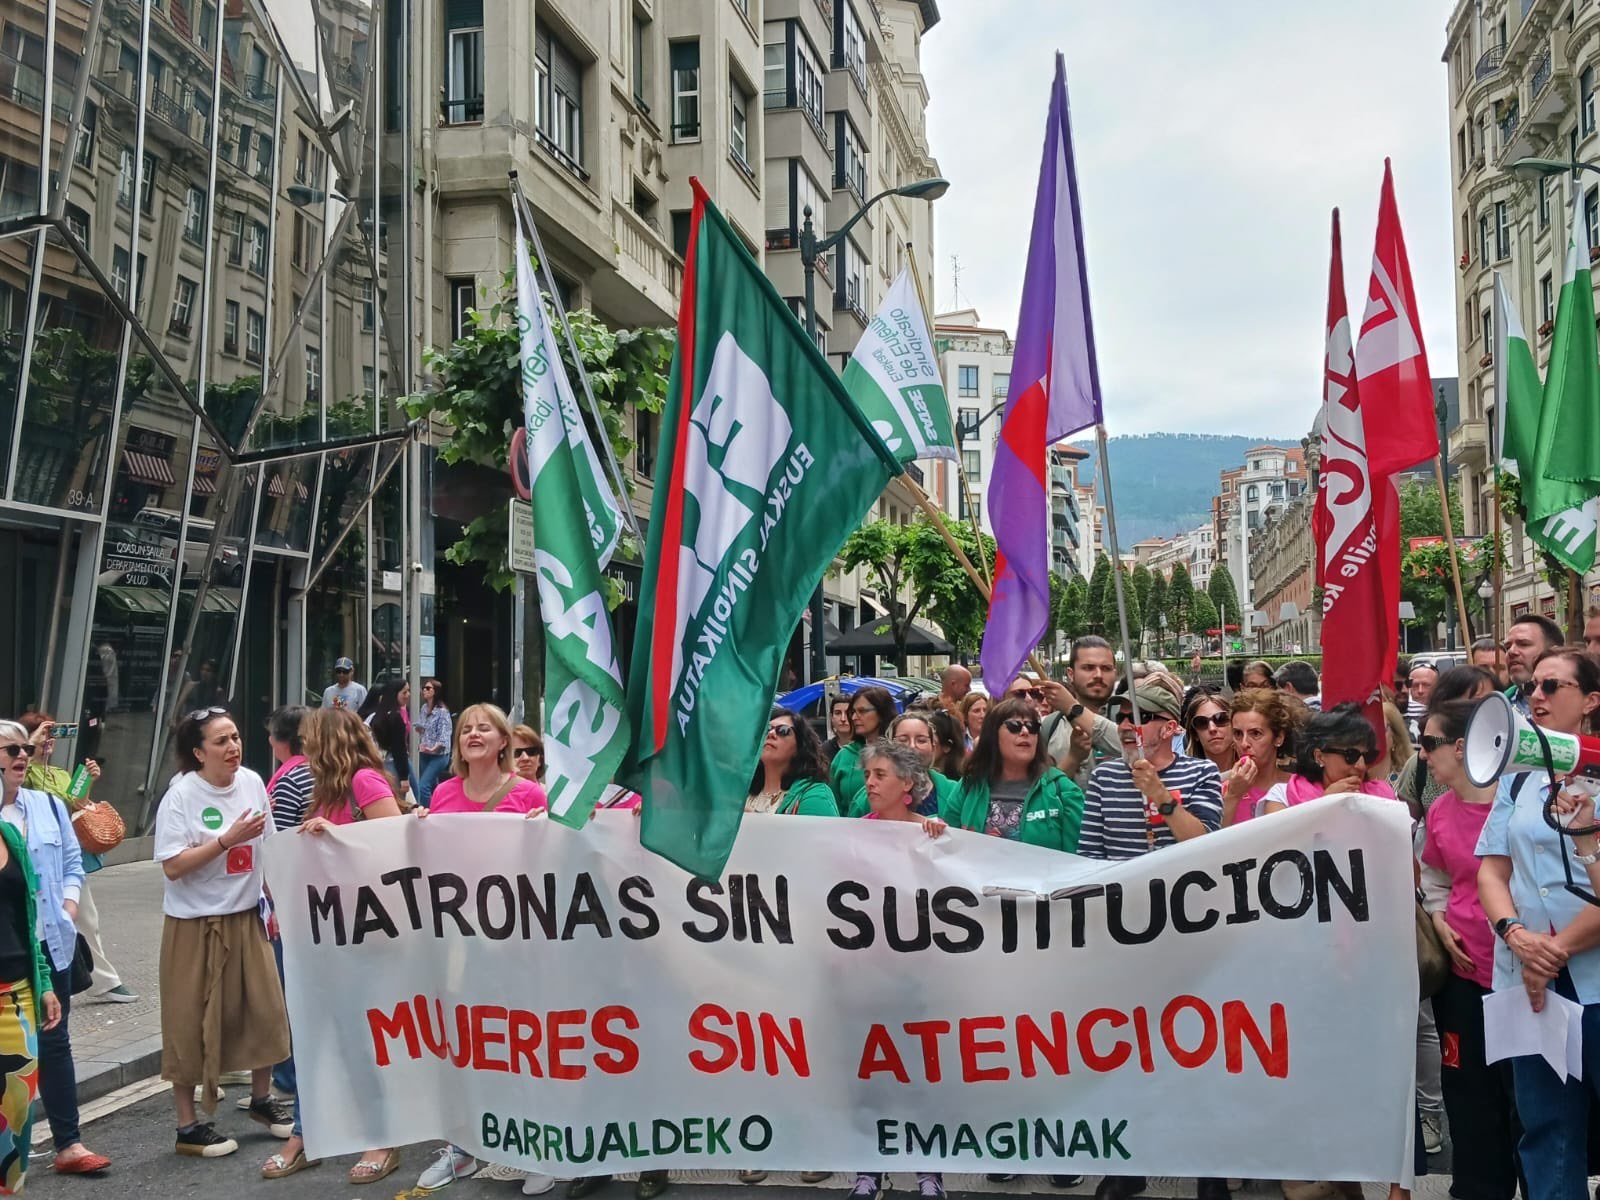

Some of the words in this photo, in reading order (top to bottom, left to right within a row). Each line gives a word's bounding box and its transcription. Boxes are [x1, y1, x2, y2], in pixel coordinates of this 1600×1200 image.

[126, 573, 148, 586] SALUD
[1519, 739, 1575, 763] SASE
[307, 866, 660, 946] MATRONAS
[682, 873, 794, 945] SIN
[826, 848, 1370, 954] SUSTITUCION
[367, 994, 640, 1081] MUJERES
[688, 1003, 810, 1078] SIN
[858, 994, 1289, 1084] ATENCION
[482, 1112, 773, 1163] BARRUALDEKO
[876, 1117, 1132, 1161] EMAGINAK
